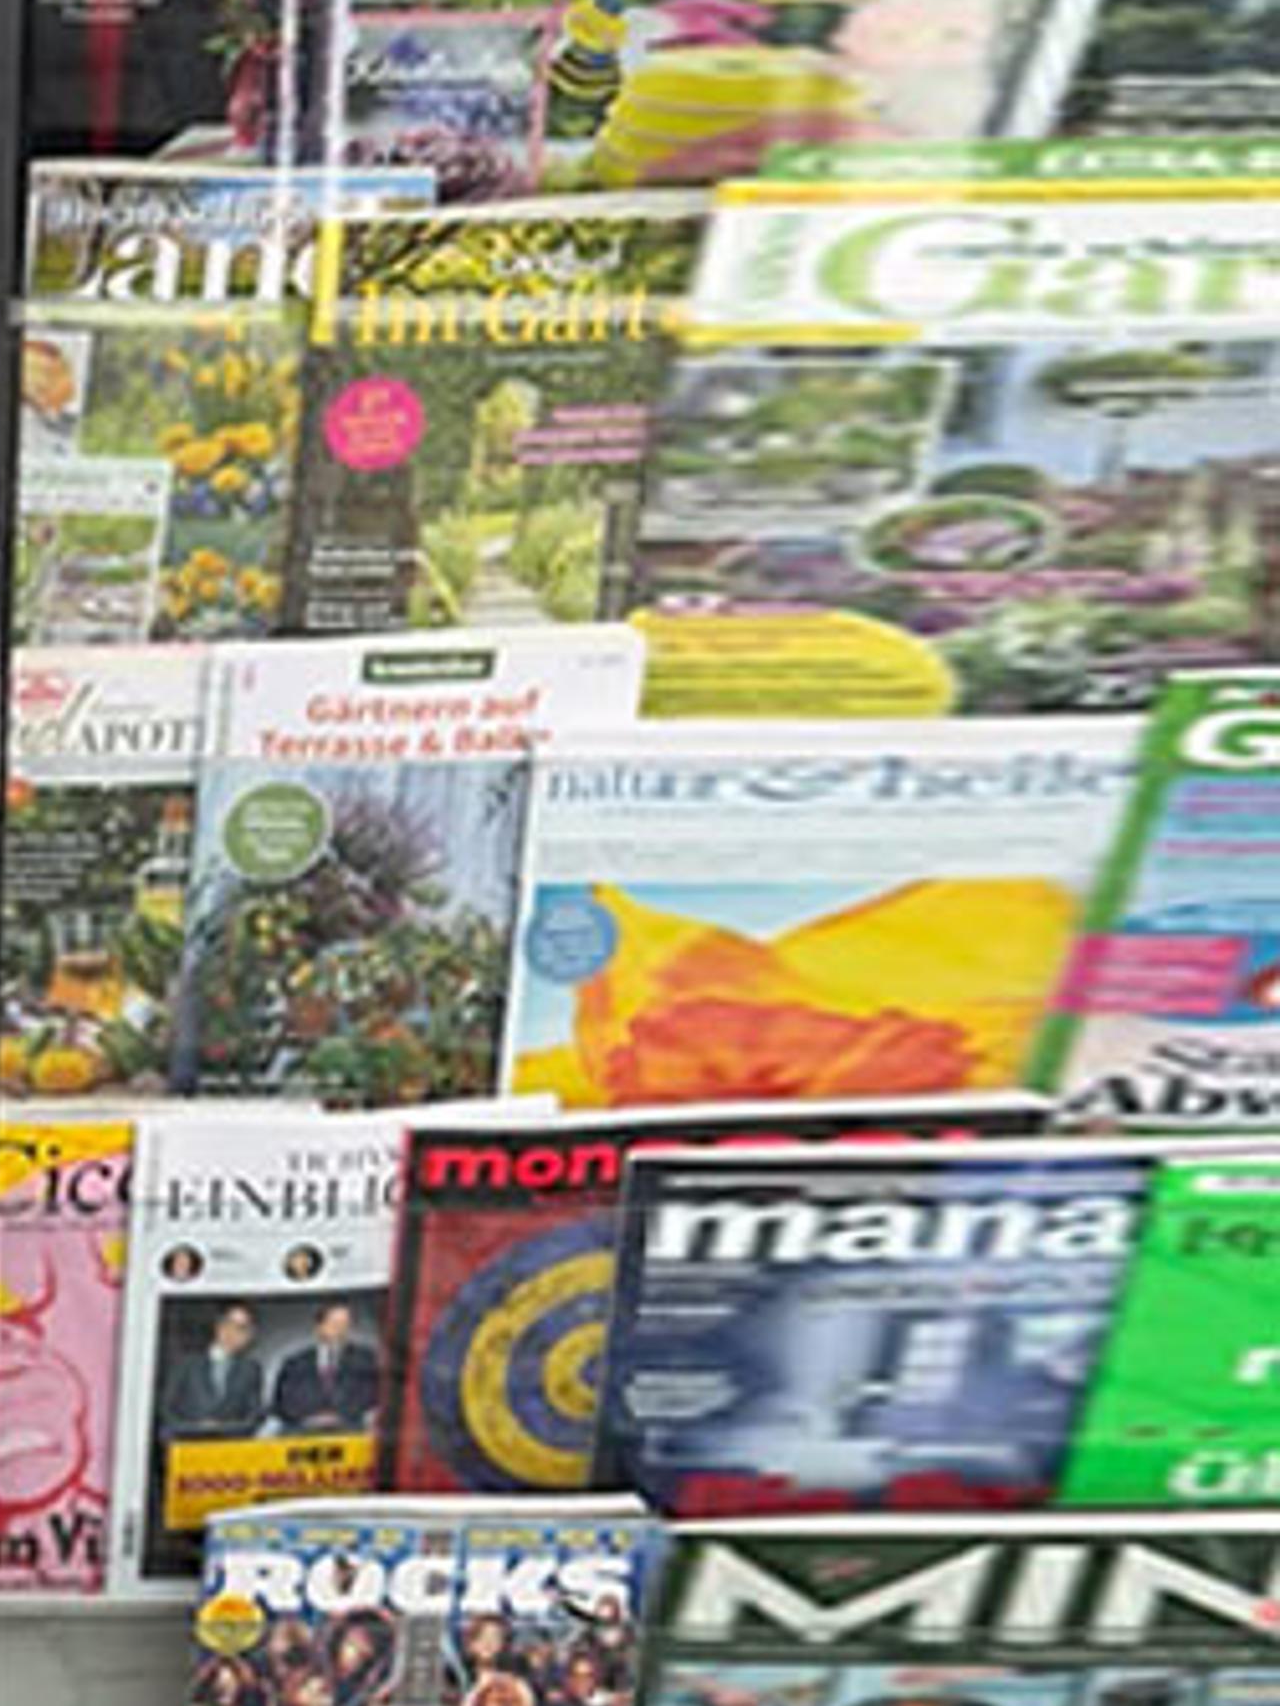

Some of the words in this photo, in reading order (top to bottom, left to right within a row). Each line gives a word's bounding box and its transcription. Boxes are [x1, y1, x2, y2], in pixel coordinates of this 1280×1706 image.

[304, 693, 462, 725] Gärtnern
[480, 687, 538, 719] auf
[644, 1193, 1138, 1261] mana
[212, 1551, 634, 1613] ROCKS
